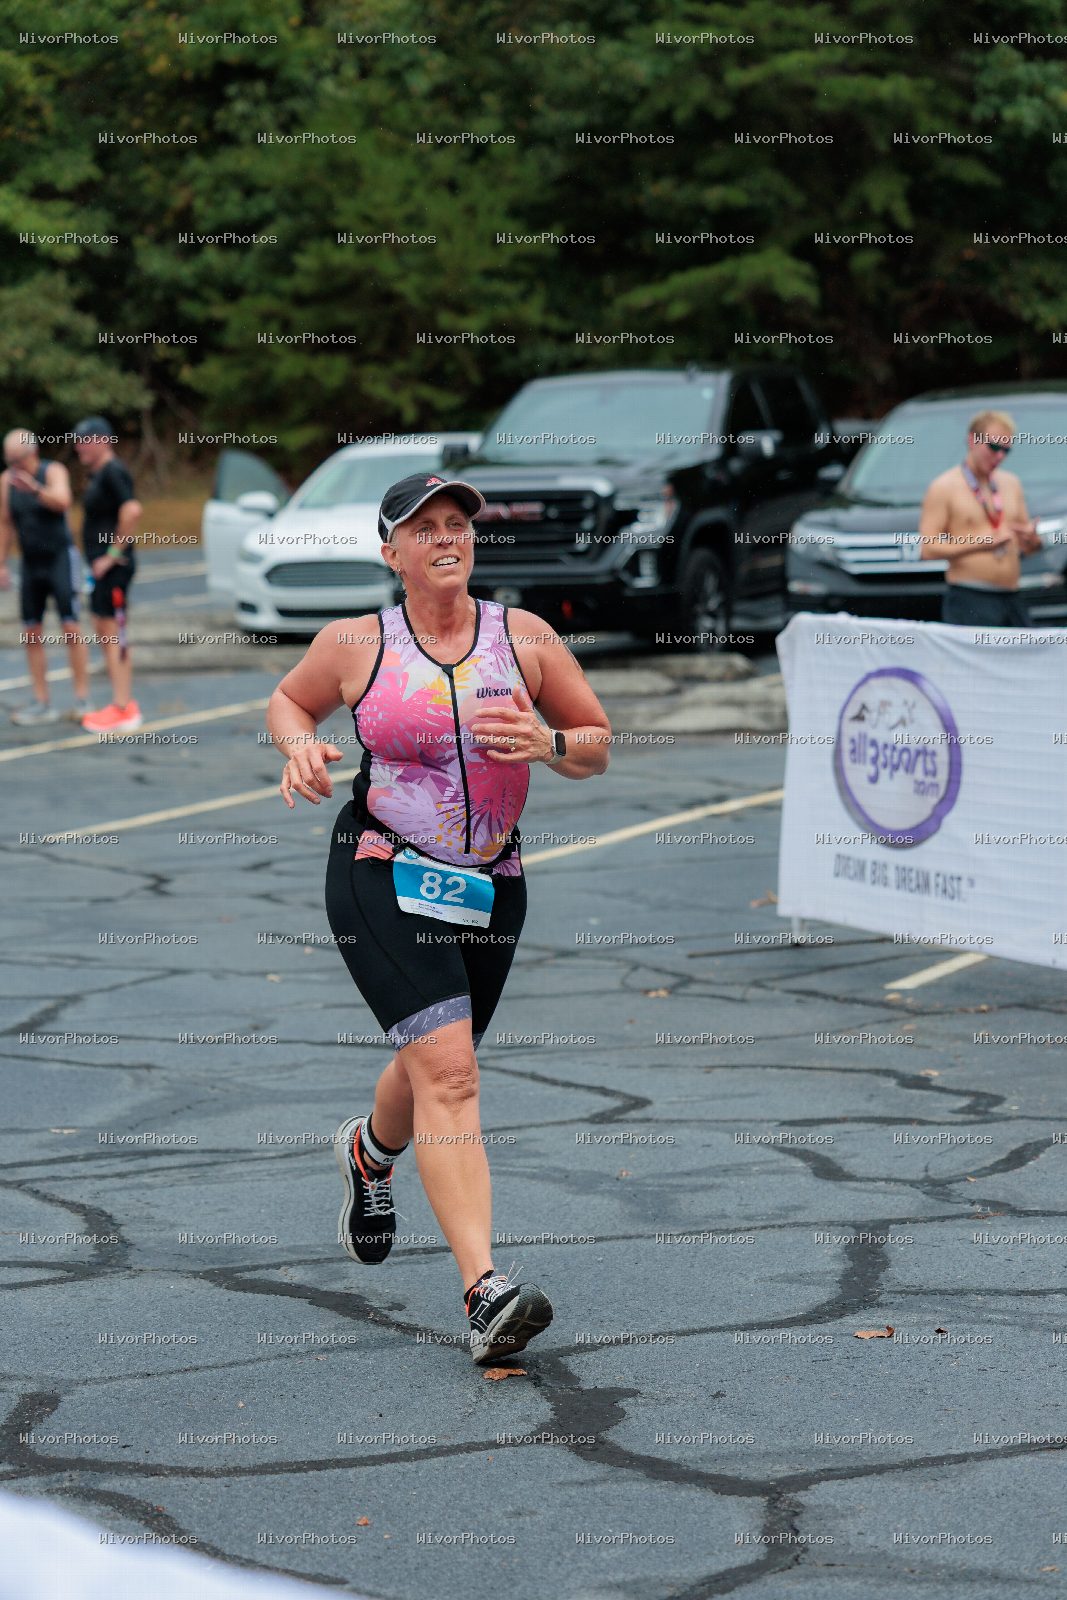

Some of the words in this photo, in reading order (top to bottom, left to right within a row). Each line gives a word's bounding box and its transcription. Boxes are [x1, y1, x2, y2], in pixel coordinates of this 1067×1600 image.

[848, 731, 938, 785] all3sports
[420, 871, 467, 904] 82
[895, 864, 931, 897] DREAM
